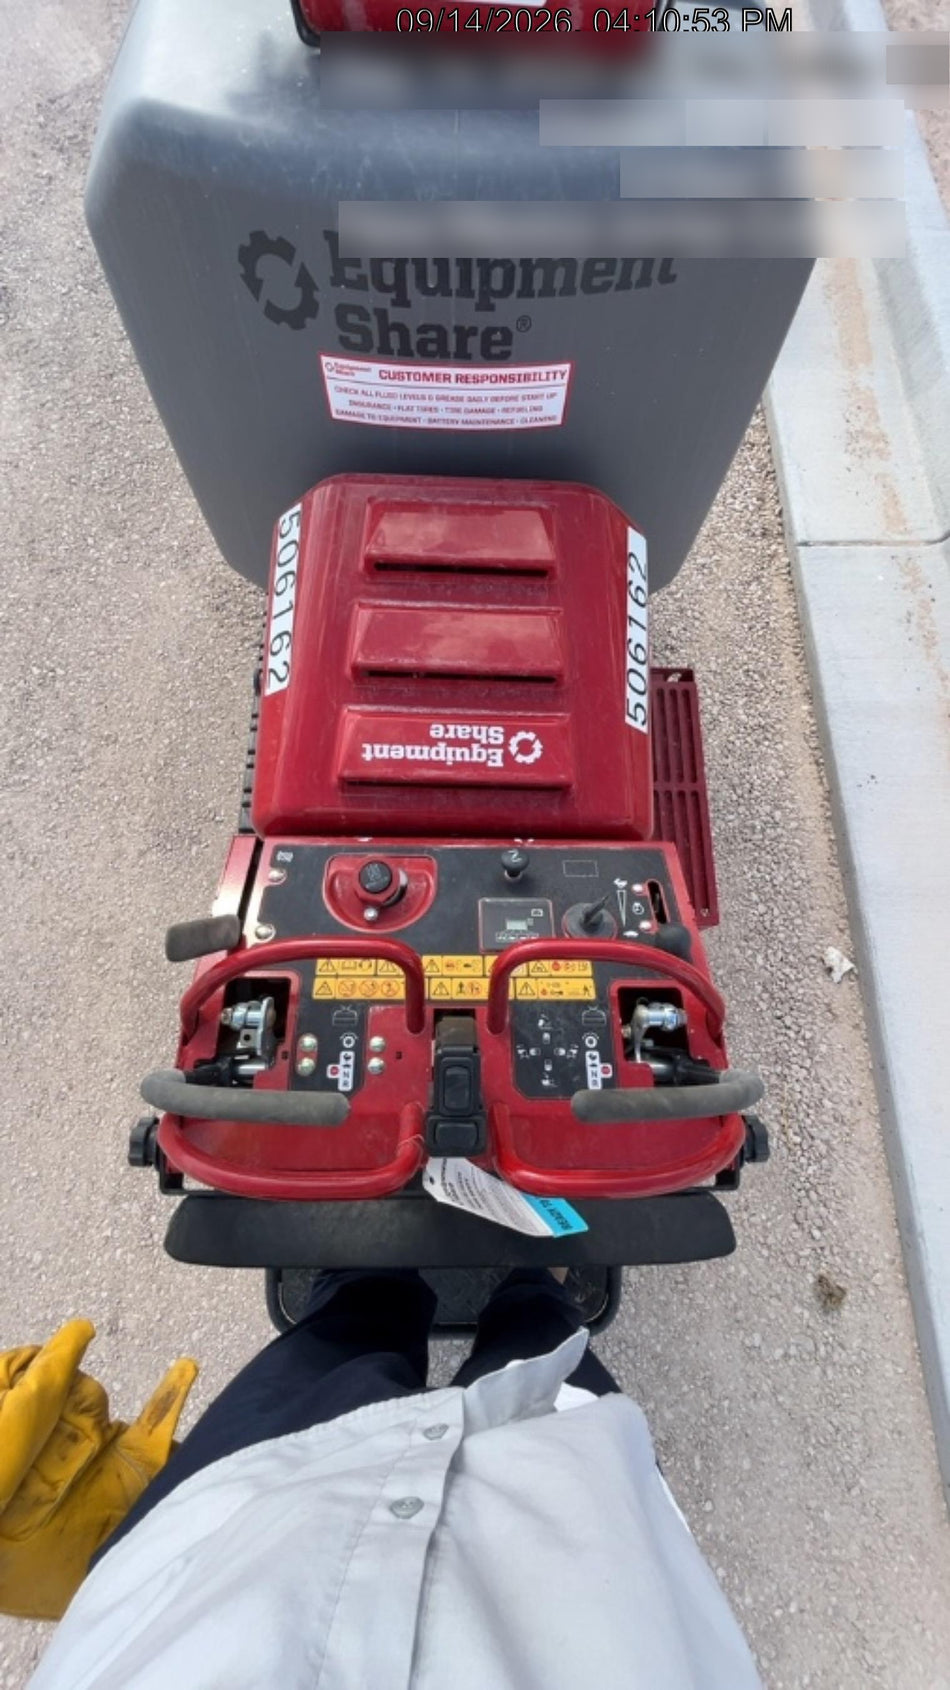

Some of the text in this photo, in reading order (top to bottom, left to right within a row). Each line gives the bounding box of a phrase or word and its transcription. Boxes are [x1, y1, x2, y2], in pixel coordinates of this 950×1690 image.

[379, 369, 568, 384] CUSTOMER RESPONSIBILITY
[268, 510, 301, 690] 506162
[626, 552, 647, 726] 506162
[429, 723, 504, 745] Share
[361, 741, 504, 767] Equipment
